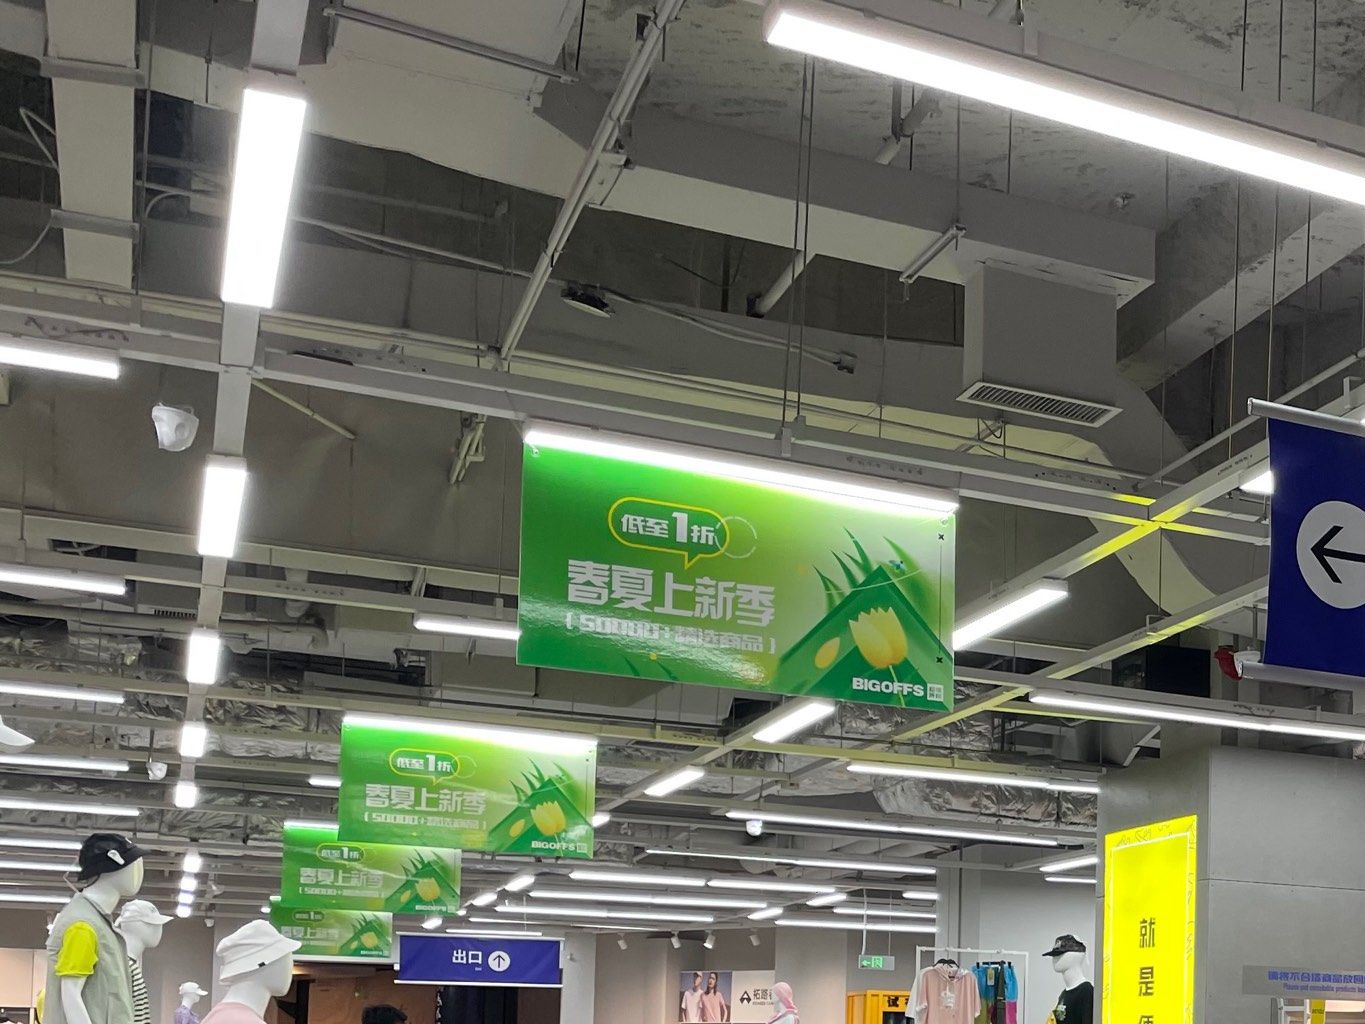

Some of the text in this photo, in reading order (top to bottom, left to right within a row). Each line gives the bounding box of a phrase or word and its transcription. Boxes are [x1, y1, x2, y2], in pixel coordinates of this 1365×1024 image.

[620, 511, 716, 546] 低至1折
[568, 560, 776, 628] 春夏上新季
[852, 677, 924, 697] BIGOFFS
[365, 784, 486, 815] 春夏上新季
[452, 949, 482, 964] 出口
